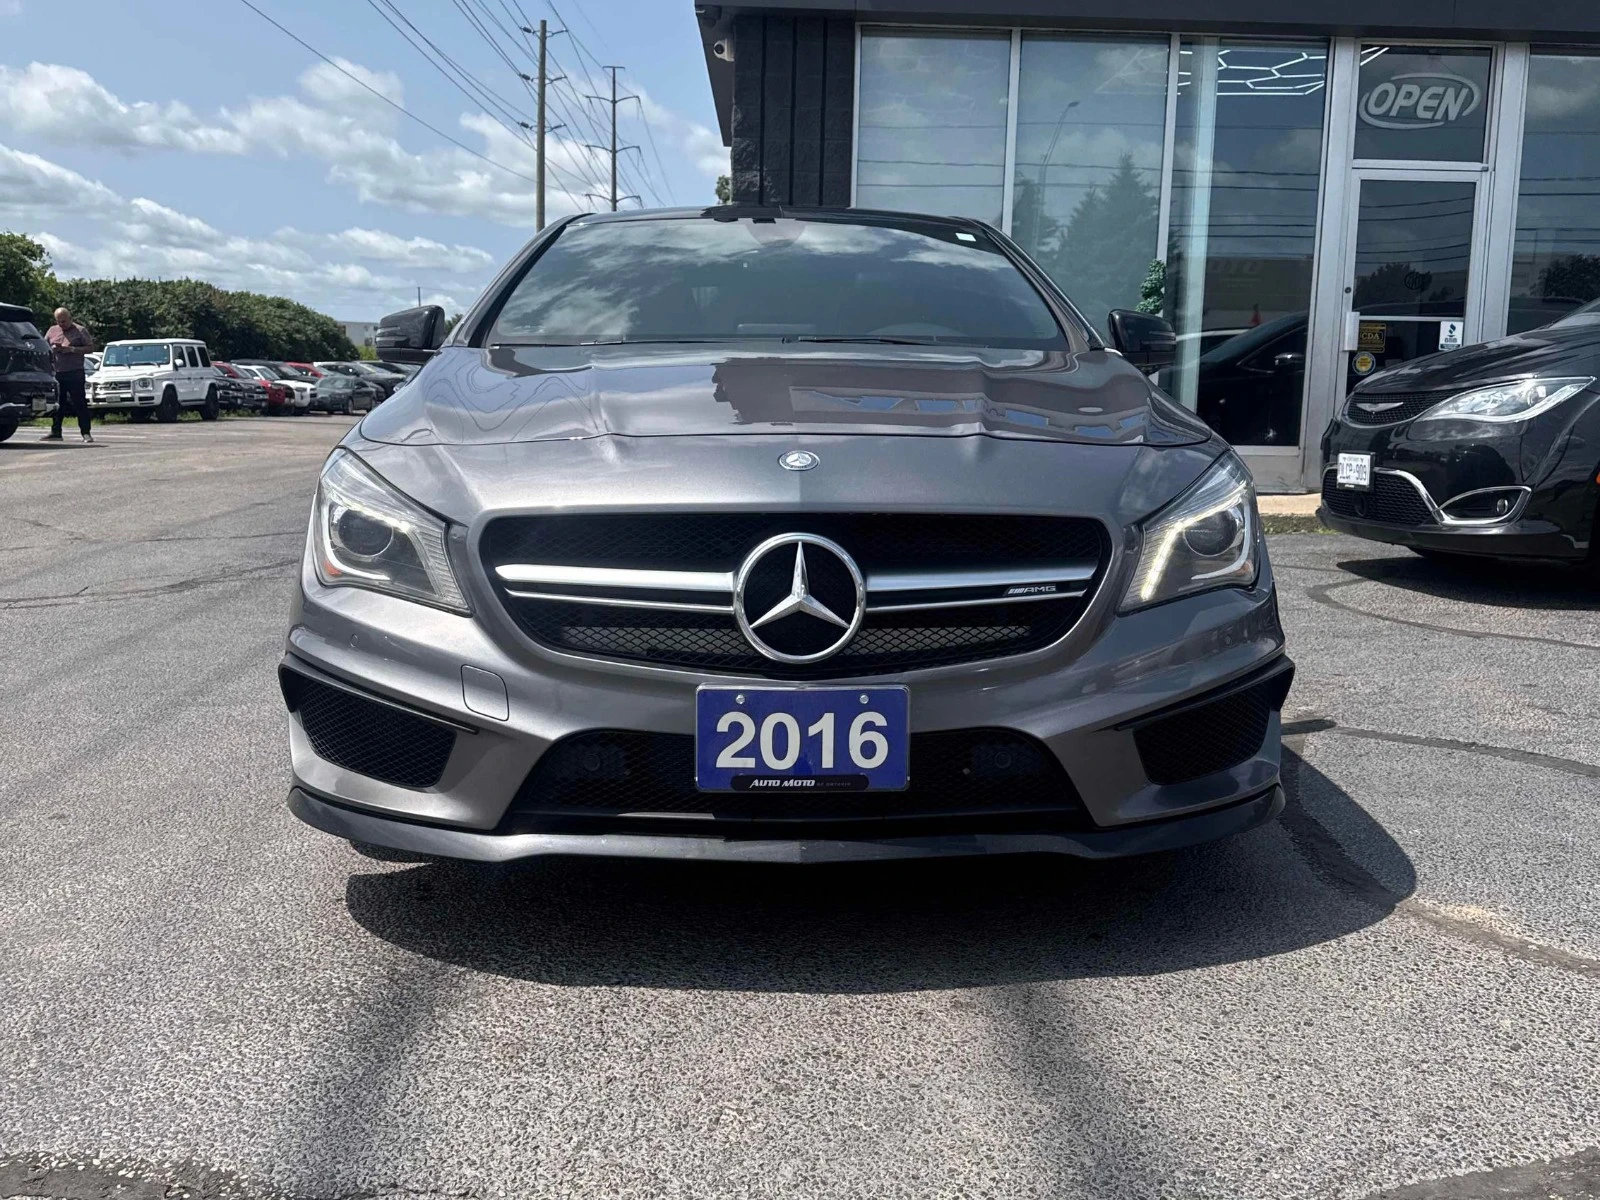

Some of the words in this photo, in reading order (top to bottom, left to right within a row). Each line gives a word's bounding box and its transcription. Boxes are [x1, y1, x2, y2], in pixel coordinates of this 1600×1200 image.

[1367, 82, 1469, 121] OPEN
[1023, 585, 1057, 594] AMG
[715, 711, 889, 770] 2016
[749, 779, 780, 788] AUTO
[782, 779, 815, 787] MOTO
